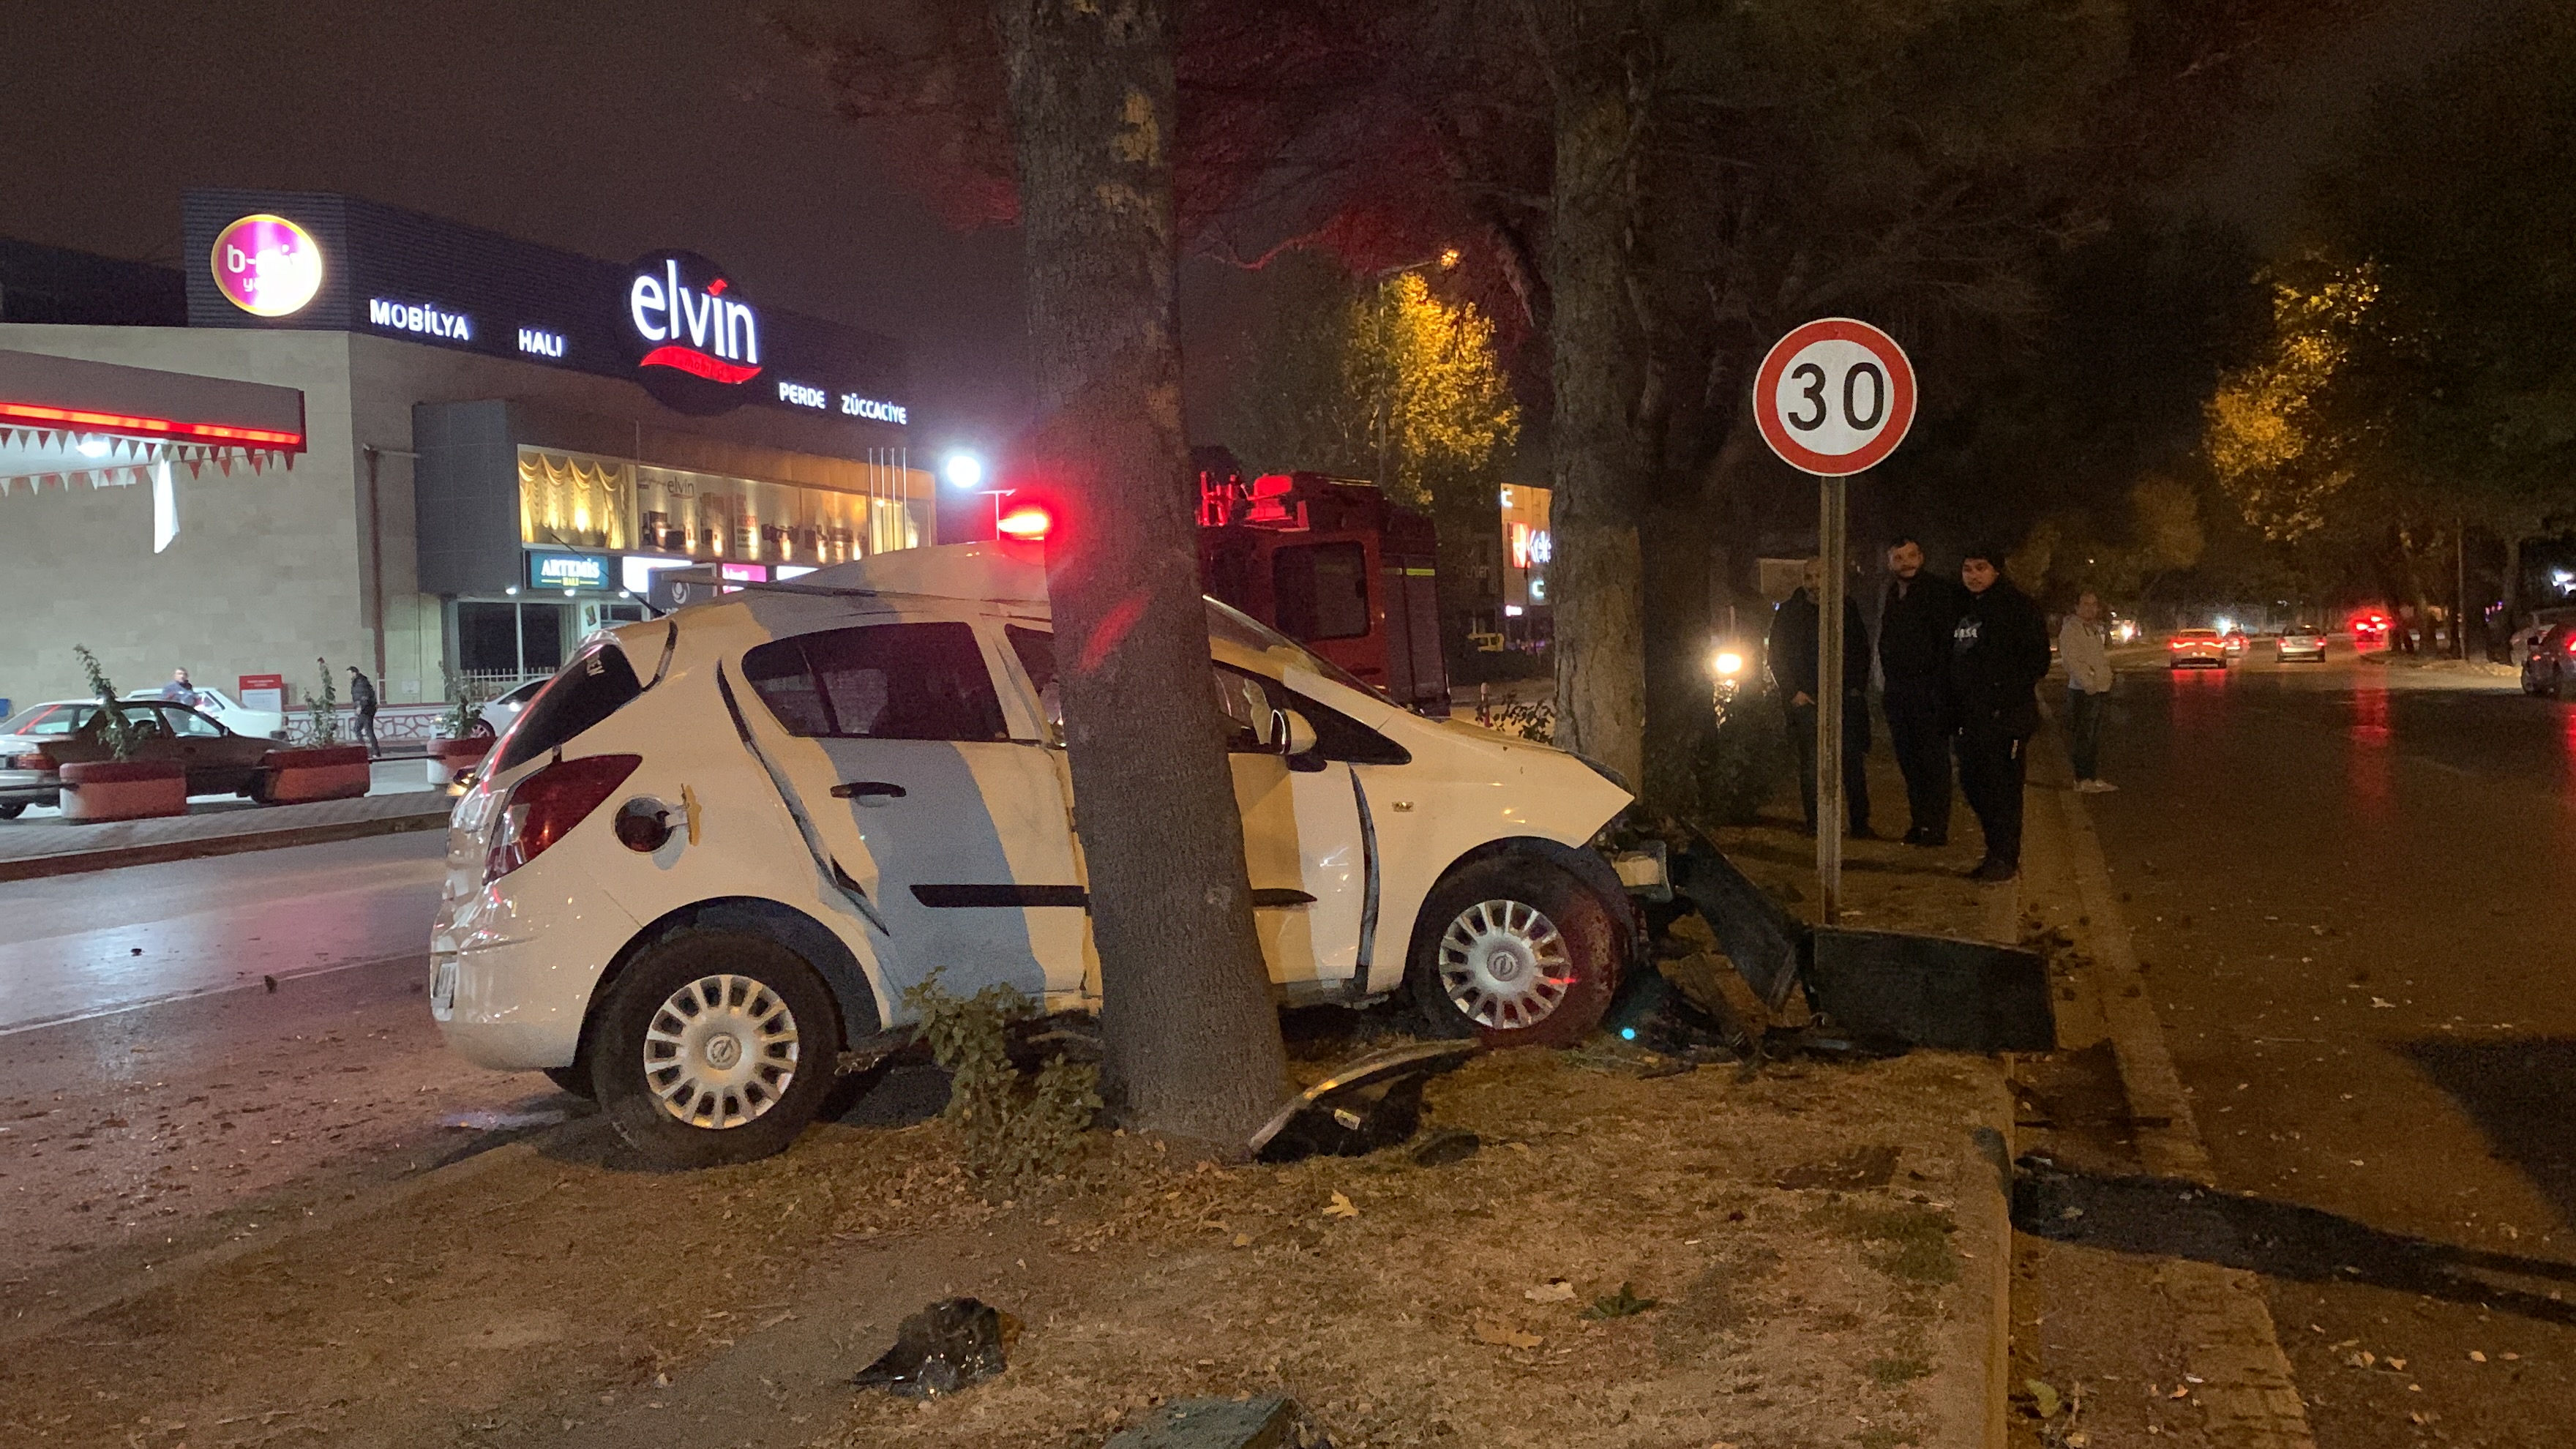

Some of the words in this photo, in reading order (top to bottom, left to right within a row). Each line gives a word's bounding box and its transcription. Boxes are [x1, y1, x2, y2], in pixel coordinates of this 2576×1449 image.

[370, 298, 469, 341] MOBİLYA
[631, 259, 757, 364] elvin
[518, 328, 562, 357] HALI
[779, 382, 825, 409] PERDE
[841, 393, 907, 424] ZÜCCACİYE
[1788, 362, 1884, 431] 30
[667, 476, 694, 495] elvin
[541, 558, 600, 578] ARTEMİS
